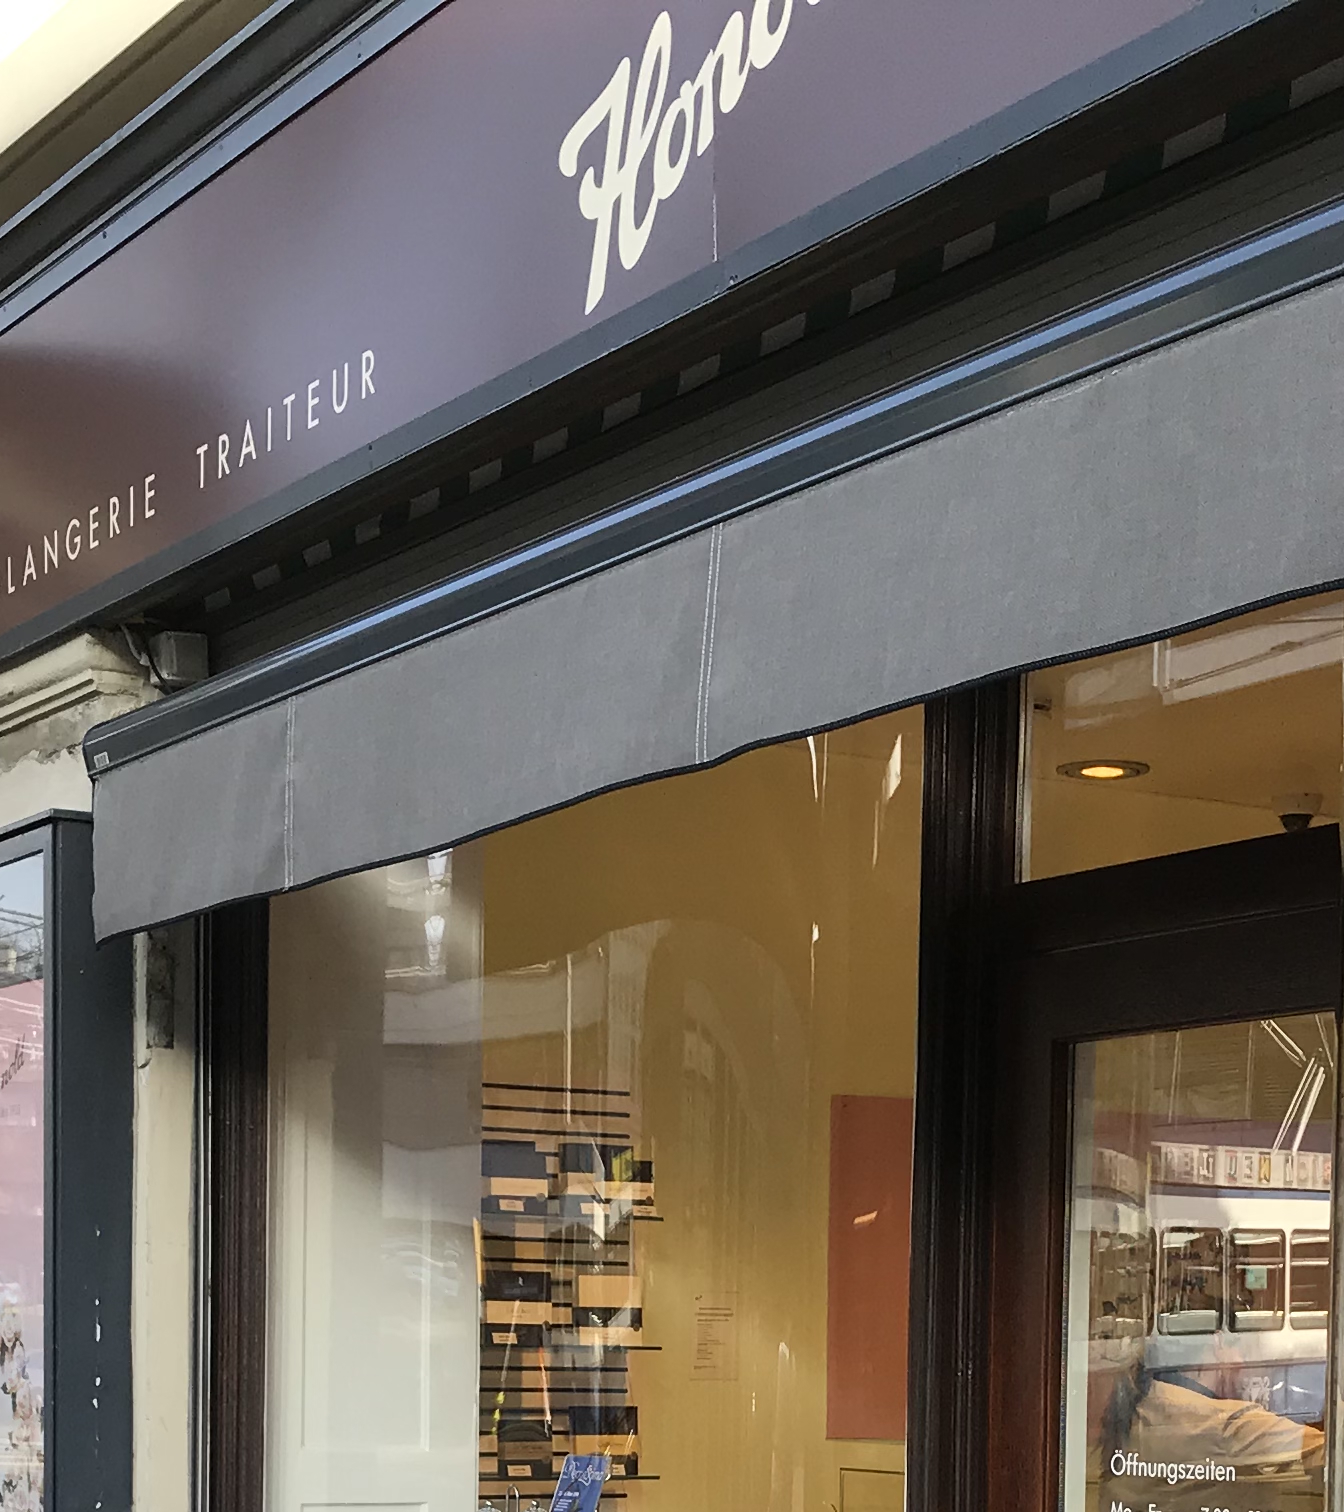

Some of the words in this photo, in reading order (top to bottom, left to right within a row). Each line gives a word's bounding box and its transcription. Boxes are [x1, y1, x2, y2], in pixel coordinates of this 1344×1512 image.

[559, 0, 822, 316] Hono
[195, 348, 379, 490] TRAITEUR
[1110, 1449, 1236, 1485] Öffnungszeiten
